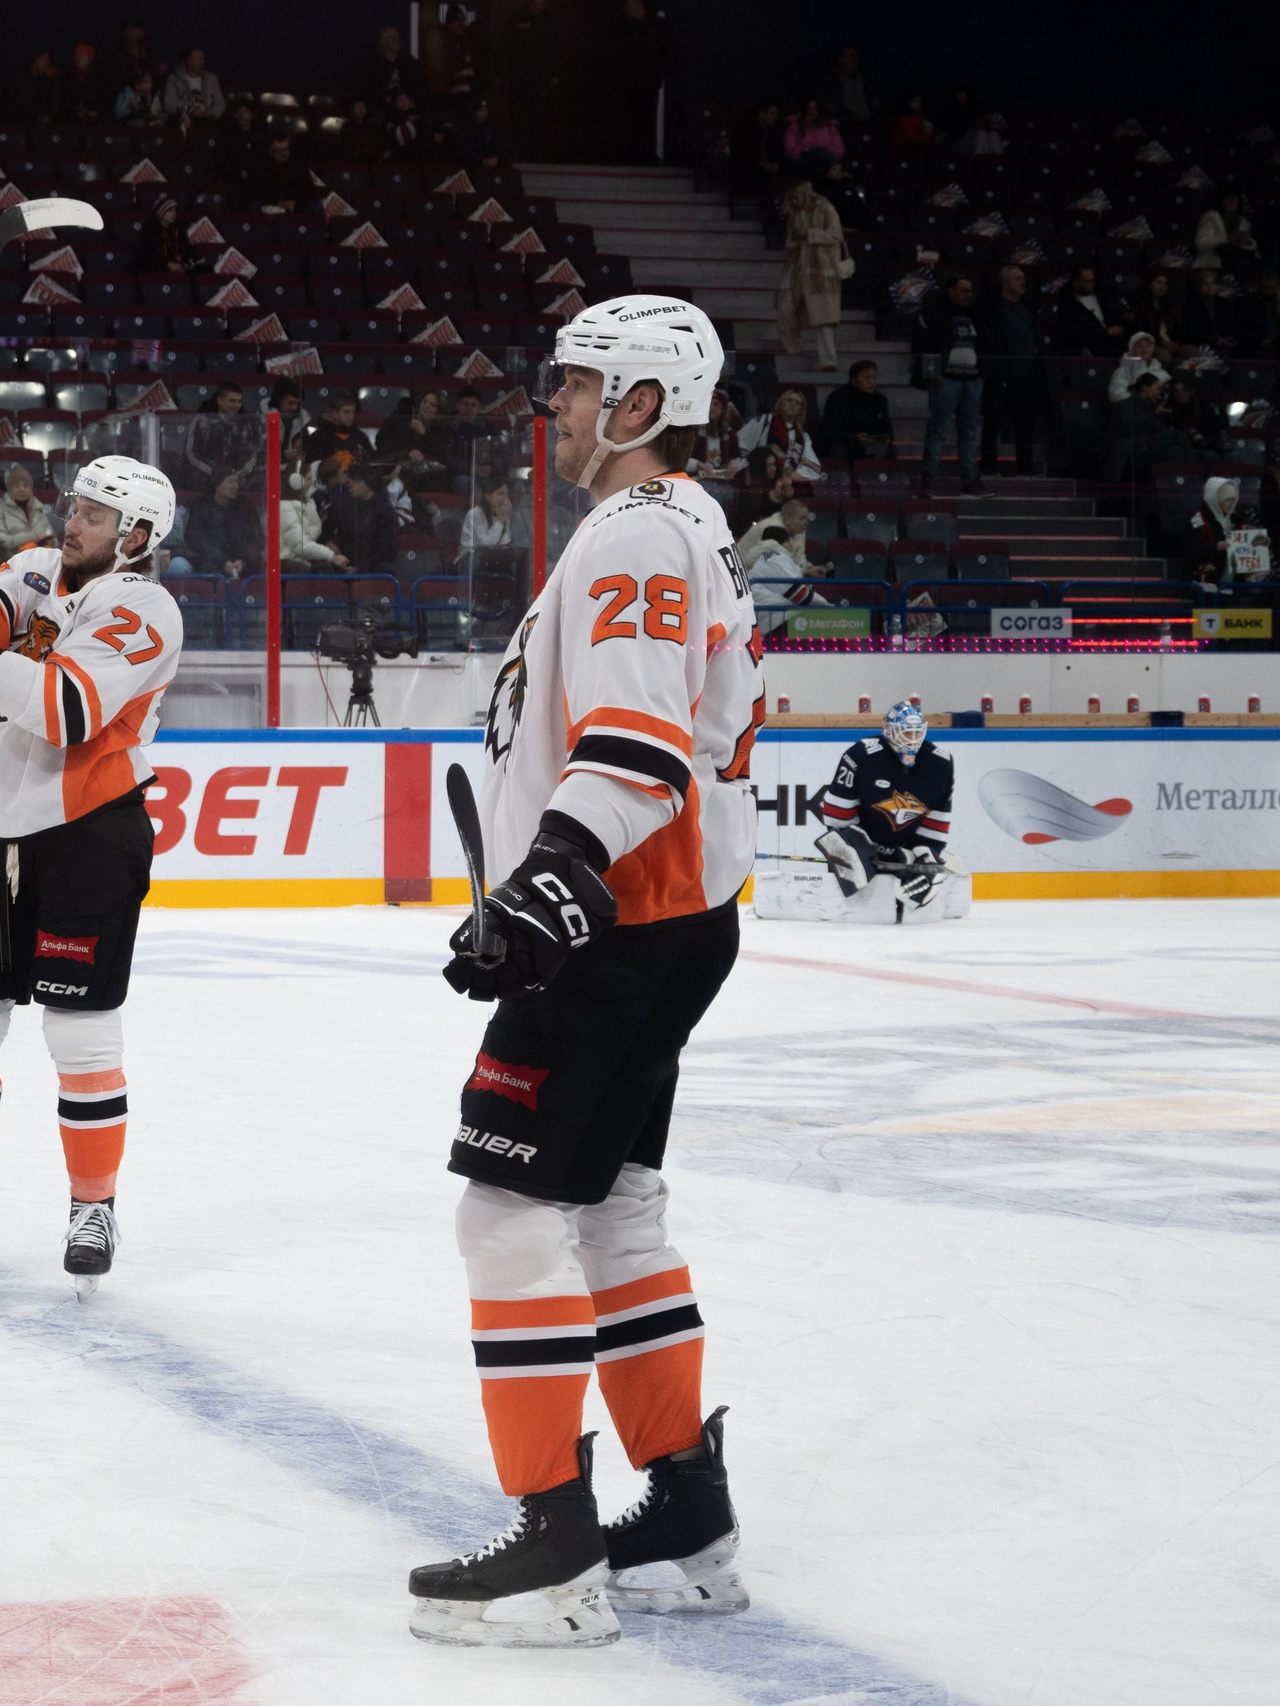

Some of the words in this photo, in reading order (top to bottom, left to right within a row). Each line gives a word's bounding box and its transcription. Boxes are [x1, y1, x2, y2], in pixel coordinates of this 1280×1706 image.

[618, 305, 687, 322] OLIMPBET
[132, 472, 168, 488] OLIMPBET
[139, 506, 160, 516] CCM
[588, 573, 690, 648] 28
[1000, 616, 1064, 631] согаз
[1224, 618, 1264, 628] БАНК
[92, 606, 164, 665] 27
[837, 766, 855, 788] 20
[1155, 782, 1280, 811] Металл
[41, 939, 67, 951] Альфа
[68, 943, 90, 954] Банк
[36, 980, 89, 996] CCM
[501, 1072, 533, 1092] Банк
